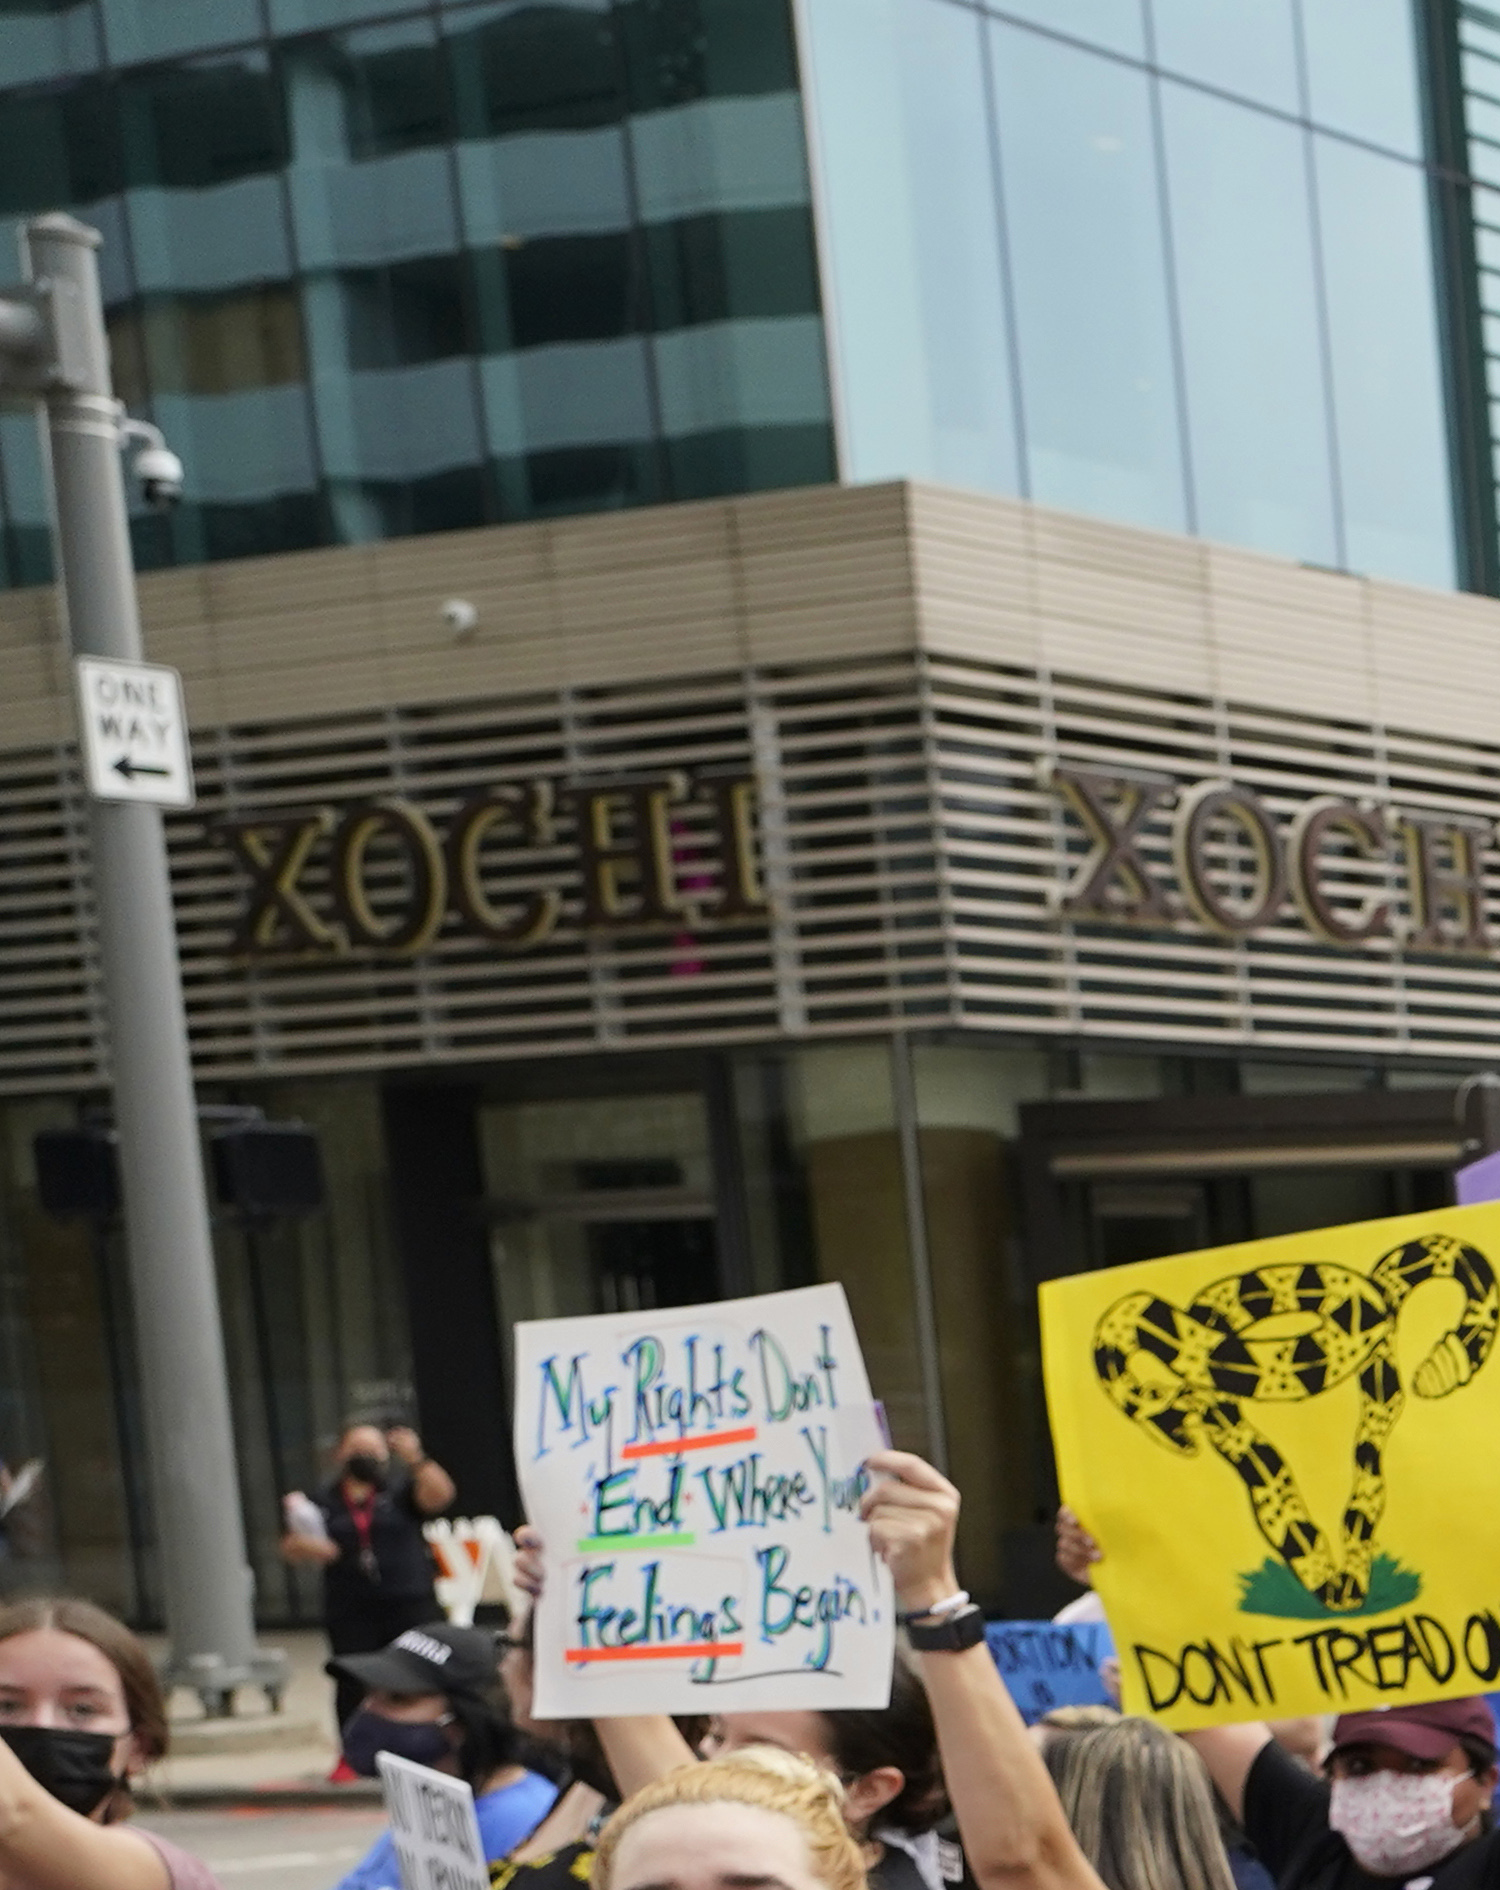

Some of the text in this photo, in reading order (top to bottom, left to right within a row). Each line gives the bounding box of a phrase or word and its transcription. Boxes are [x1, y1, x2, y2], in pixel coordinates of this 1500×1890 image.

[95, 674, 167, 716] ONE
[98, 714, 173, 750] WAY
[213, 771, 778, 964] XOCHI
[534, 1355, 618, 1476] My
[623, 1336, 751, 1466] Rights
[588, 1465, 685, 1538] End
[577, 1561, 743, 1682] Feelings
[1293, 1612, 1455, 1700] TREAD
